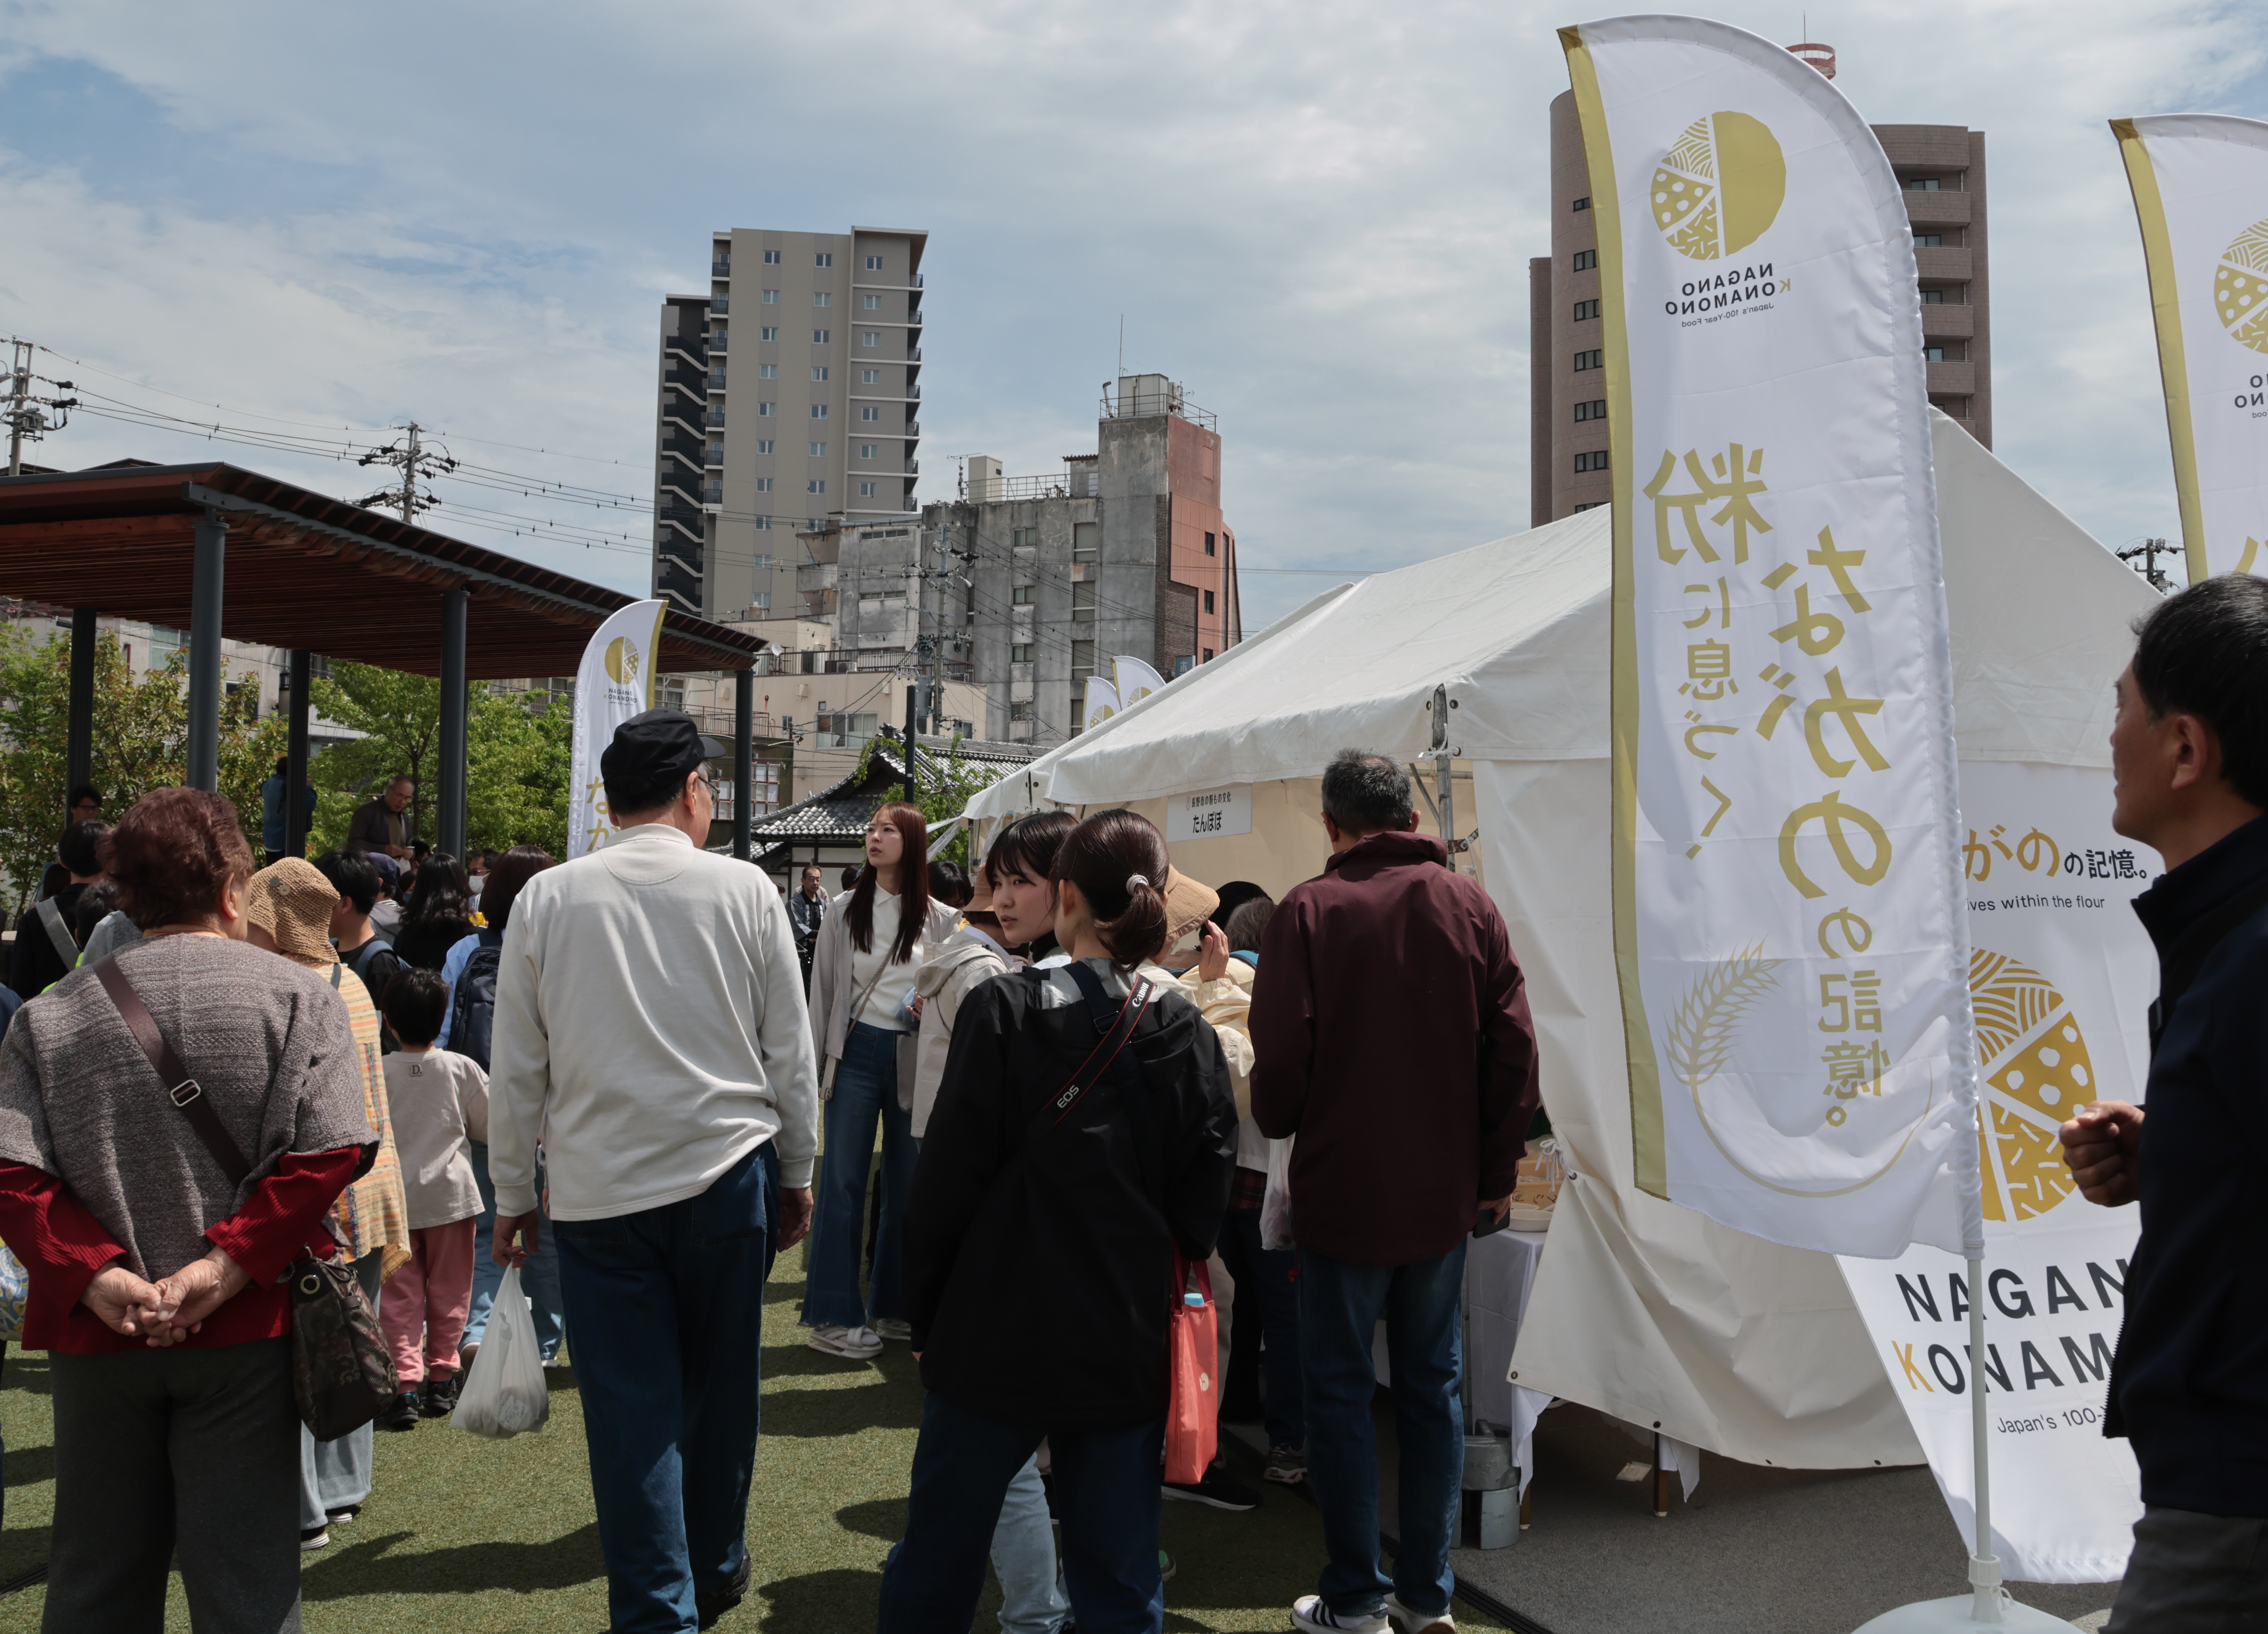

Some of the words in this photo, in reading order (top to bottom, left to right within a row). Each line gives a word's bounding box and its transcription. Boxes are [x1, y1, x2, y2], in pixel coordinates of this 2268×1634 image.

[1192, 791, 1231, 808] 長野市の粉もの文化
[1193, 810, 1222, 834] たんぽぽ
[2001, 894, 2049, 909] within
[2052, 895, 2072, 908] the
[2076, 895, 2105, 910] flour
[1132, 982, 1149, 1007] Canon
[1057, 1084, 1079, 1108] EOS
[1997, 1415, 2057, 1434] Japan's
[2062, 1406, 2107, 1426] 100-
